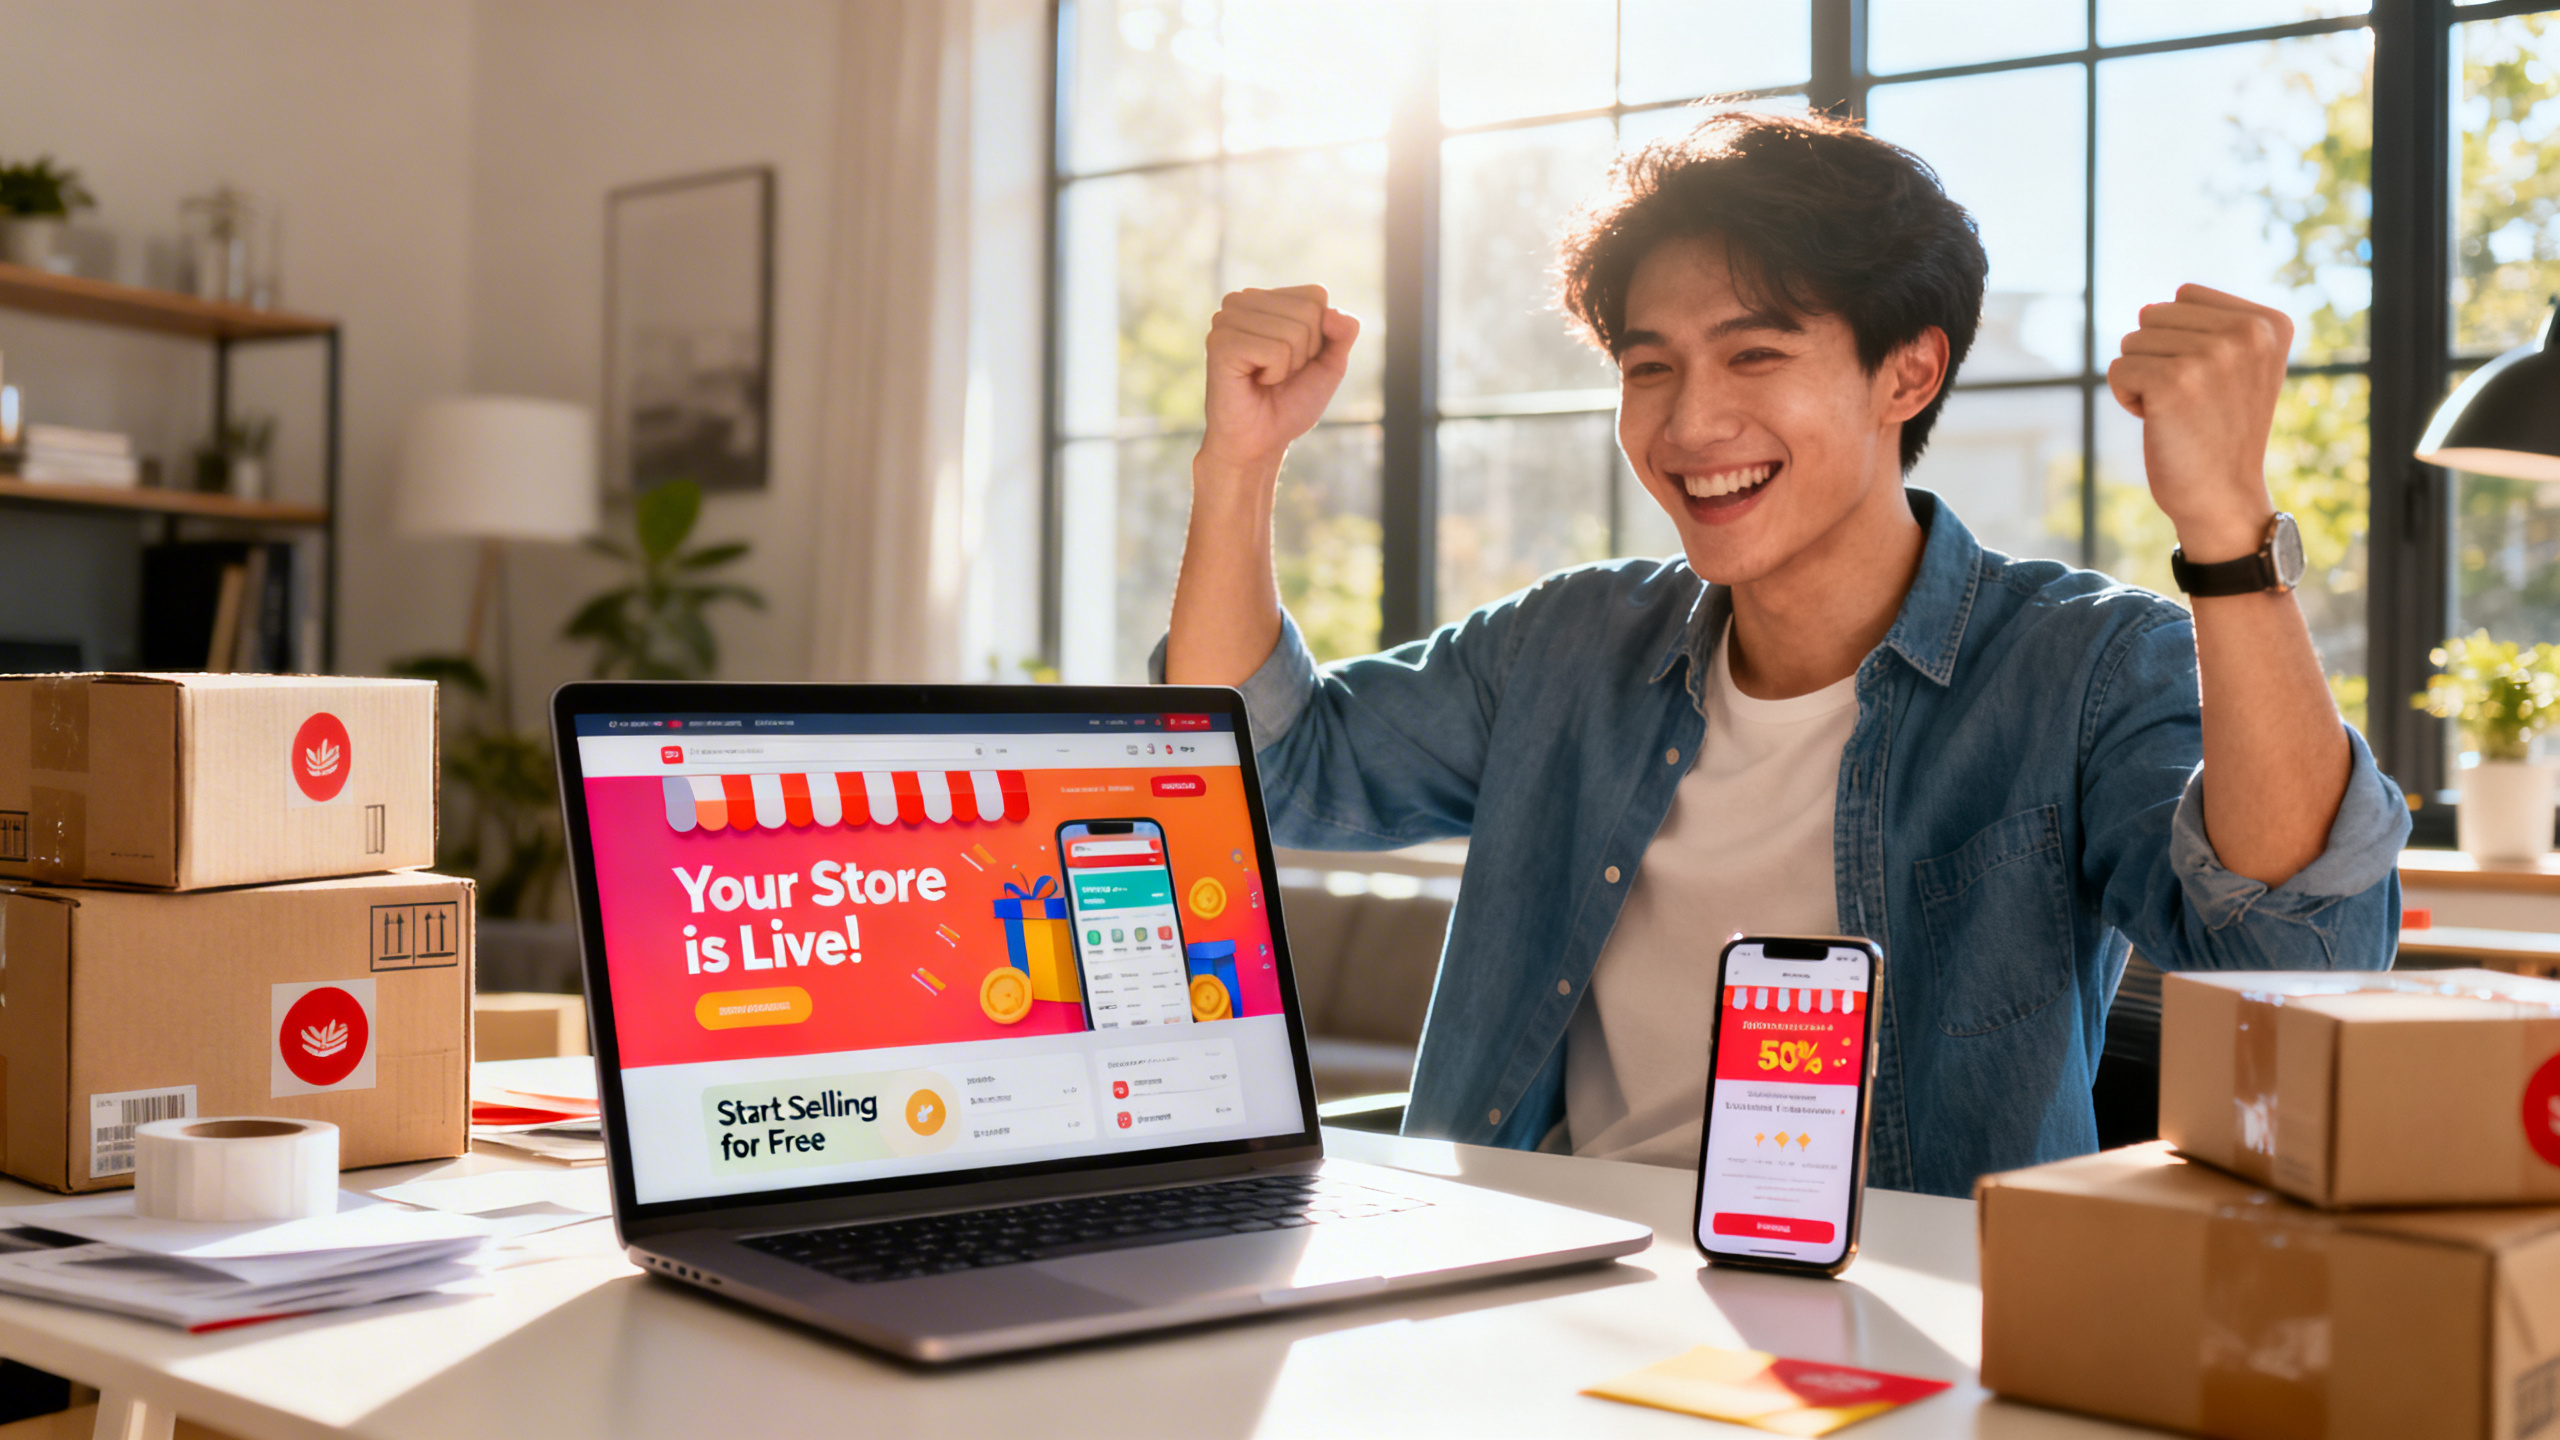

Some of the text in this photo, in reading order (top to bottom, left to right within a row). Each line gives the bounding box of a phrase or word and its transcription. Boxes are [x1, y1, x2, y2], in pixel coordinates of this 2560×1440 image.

[672, 860, 947, 913] Your Store
[683, 914, 862, 975] is Live!
[1758, 1040, 1823, 1074] 50%
[717, 1090, 877, 1126] Start Selling
[721, 1129, 826, 1161] for Free
